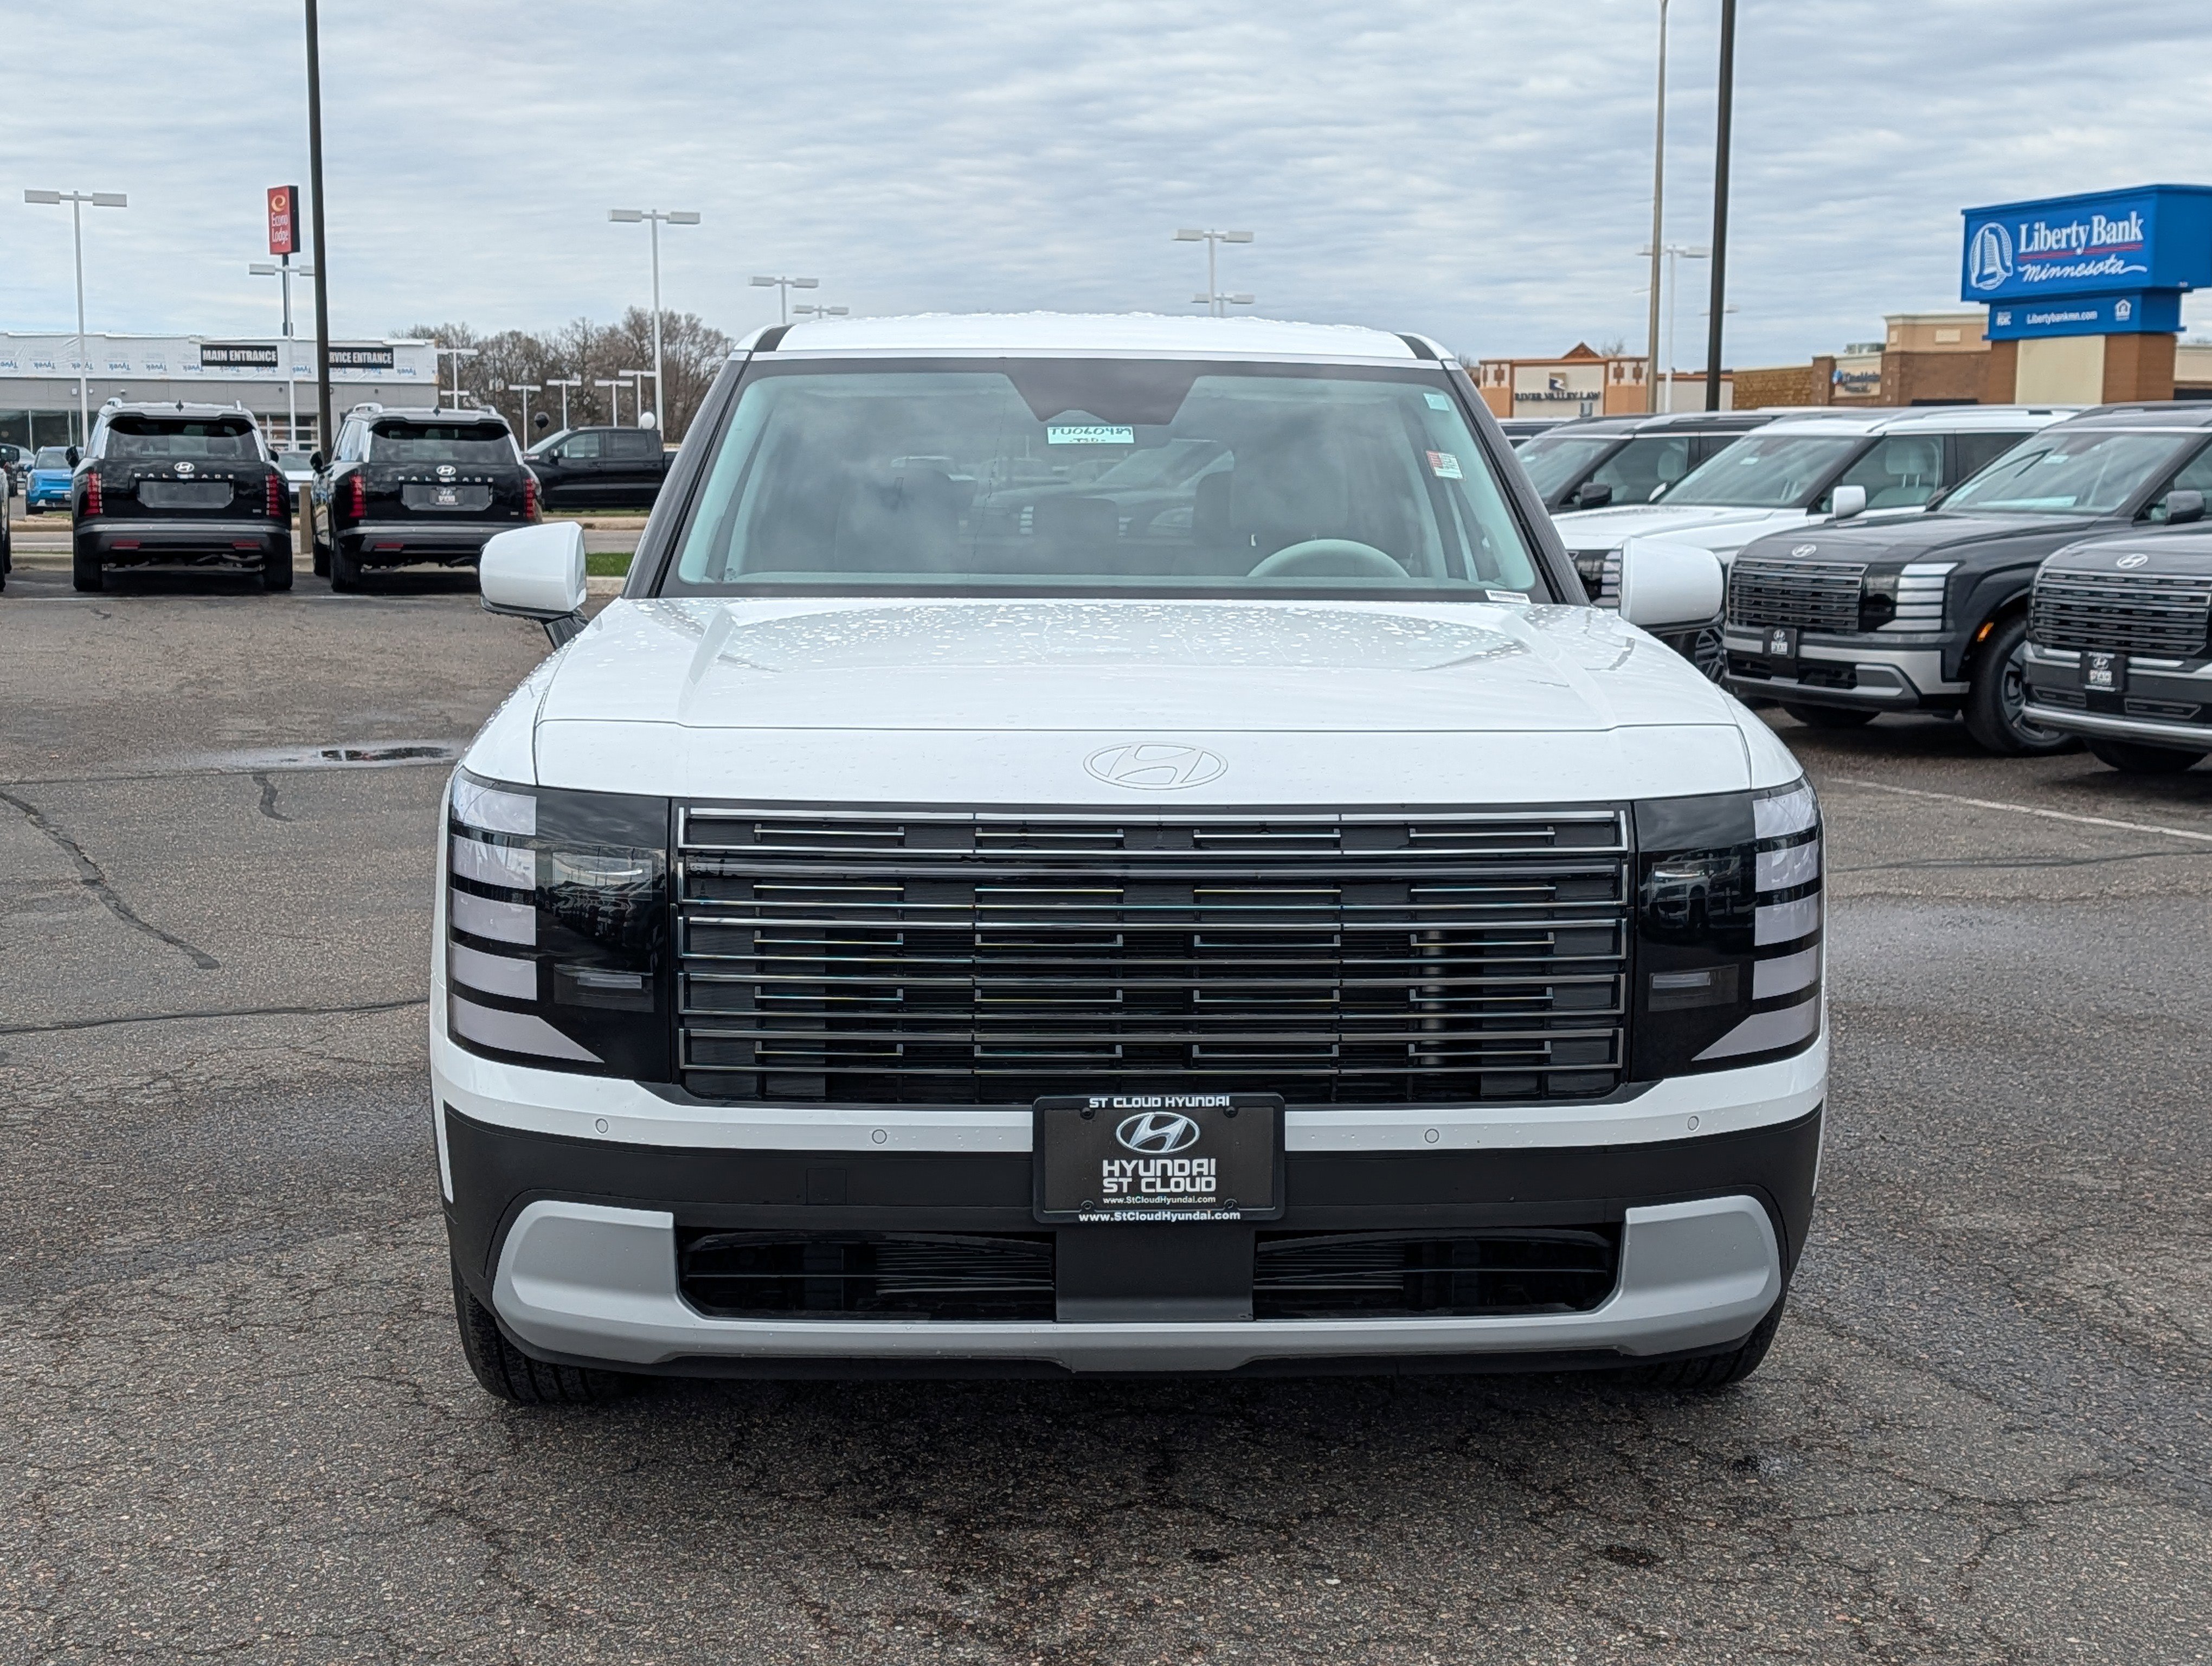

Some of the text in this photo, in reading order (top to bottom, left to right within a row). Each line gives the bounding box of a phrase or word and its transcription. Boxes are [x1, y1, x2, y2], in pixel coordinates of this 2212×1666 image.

[271, 212, 288, 227] Econo
[272, 227, 288, 245] Lodge
[2018, 210, 2144, 255] Liberty Bank
[2017, 254, 2148, 282] Minnesota
[202, 349, 277, 362] MAIN ENTRANCE
[329, 352, 392, 364] RVICE ENTRANCE
[34, 361, 55, 369] Tyvek
[71, 362, 94, 370] Tyek
[108, 363, 131, 371] Tyvek
[146, 363, 168, 371] Tyvek
[1514, 391, 1601, 401] RIVER VALLEY LAW
[1089, 1095, 1230, 1108] ST CLOUD HYUNDAI
[1102, 1158, 1216, 1177] HYUNDAI
[1103, 1177, 1216, 1193] ST CLOUD
[1103, 1195, 1216, 1204] www.StCloudHyundai.com
[1079, 1210, 1241, 1222] www.StCloudHyundai.com
